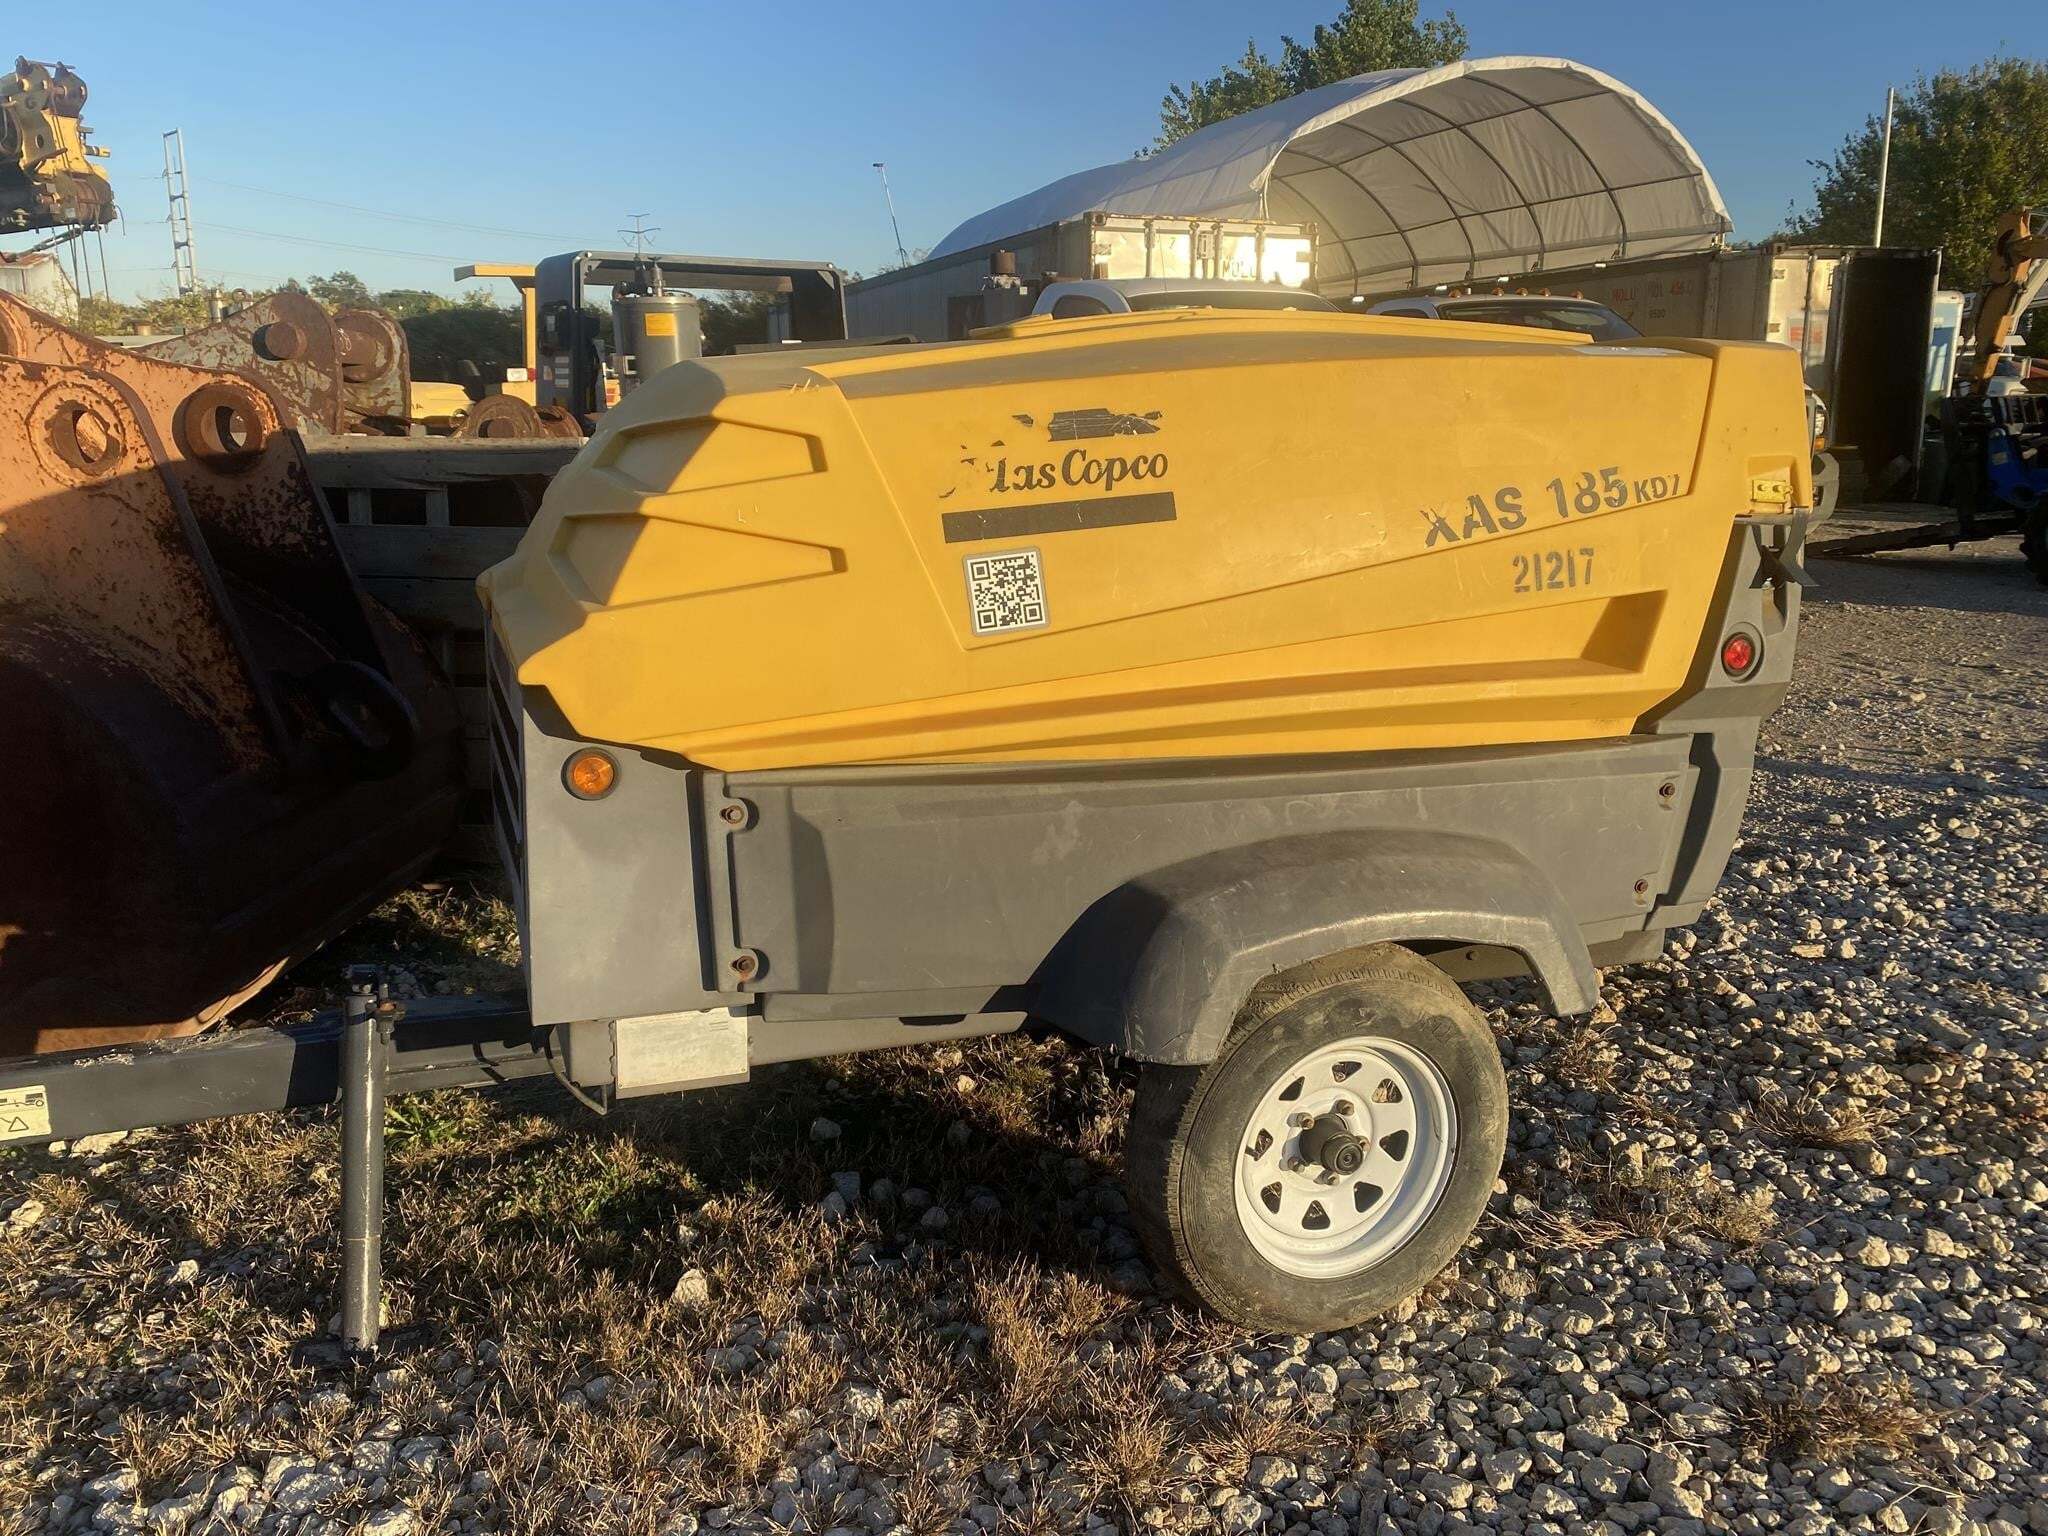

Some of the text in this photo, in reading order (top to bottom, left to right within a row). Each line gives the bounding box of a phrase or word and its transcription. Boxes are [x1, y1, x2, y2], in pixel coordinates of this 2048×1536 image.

[1061, 448, 1168, 491] Copco
[1420, 486, 1527, 547] XAS
[1546, 466, 1628, 519] 185
[1512, 548, 1594, 593] 21217
